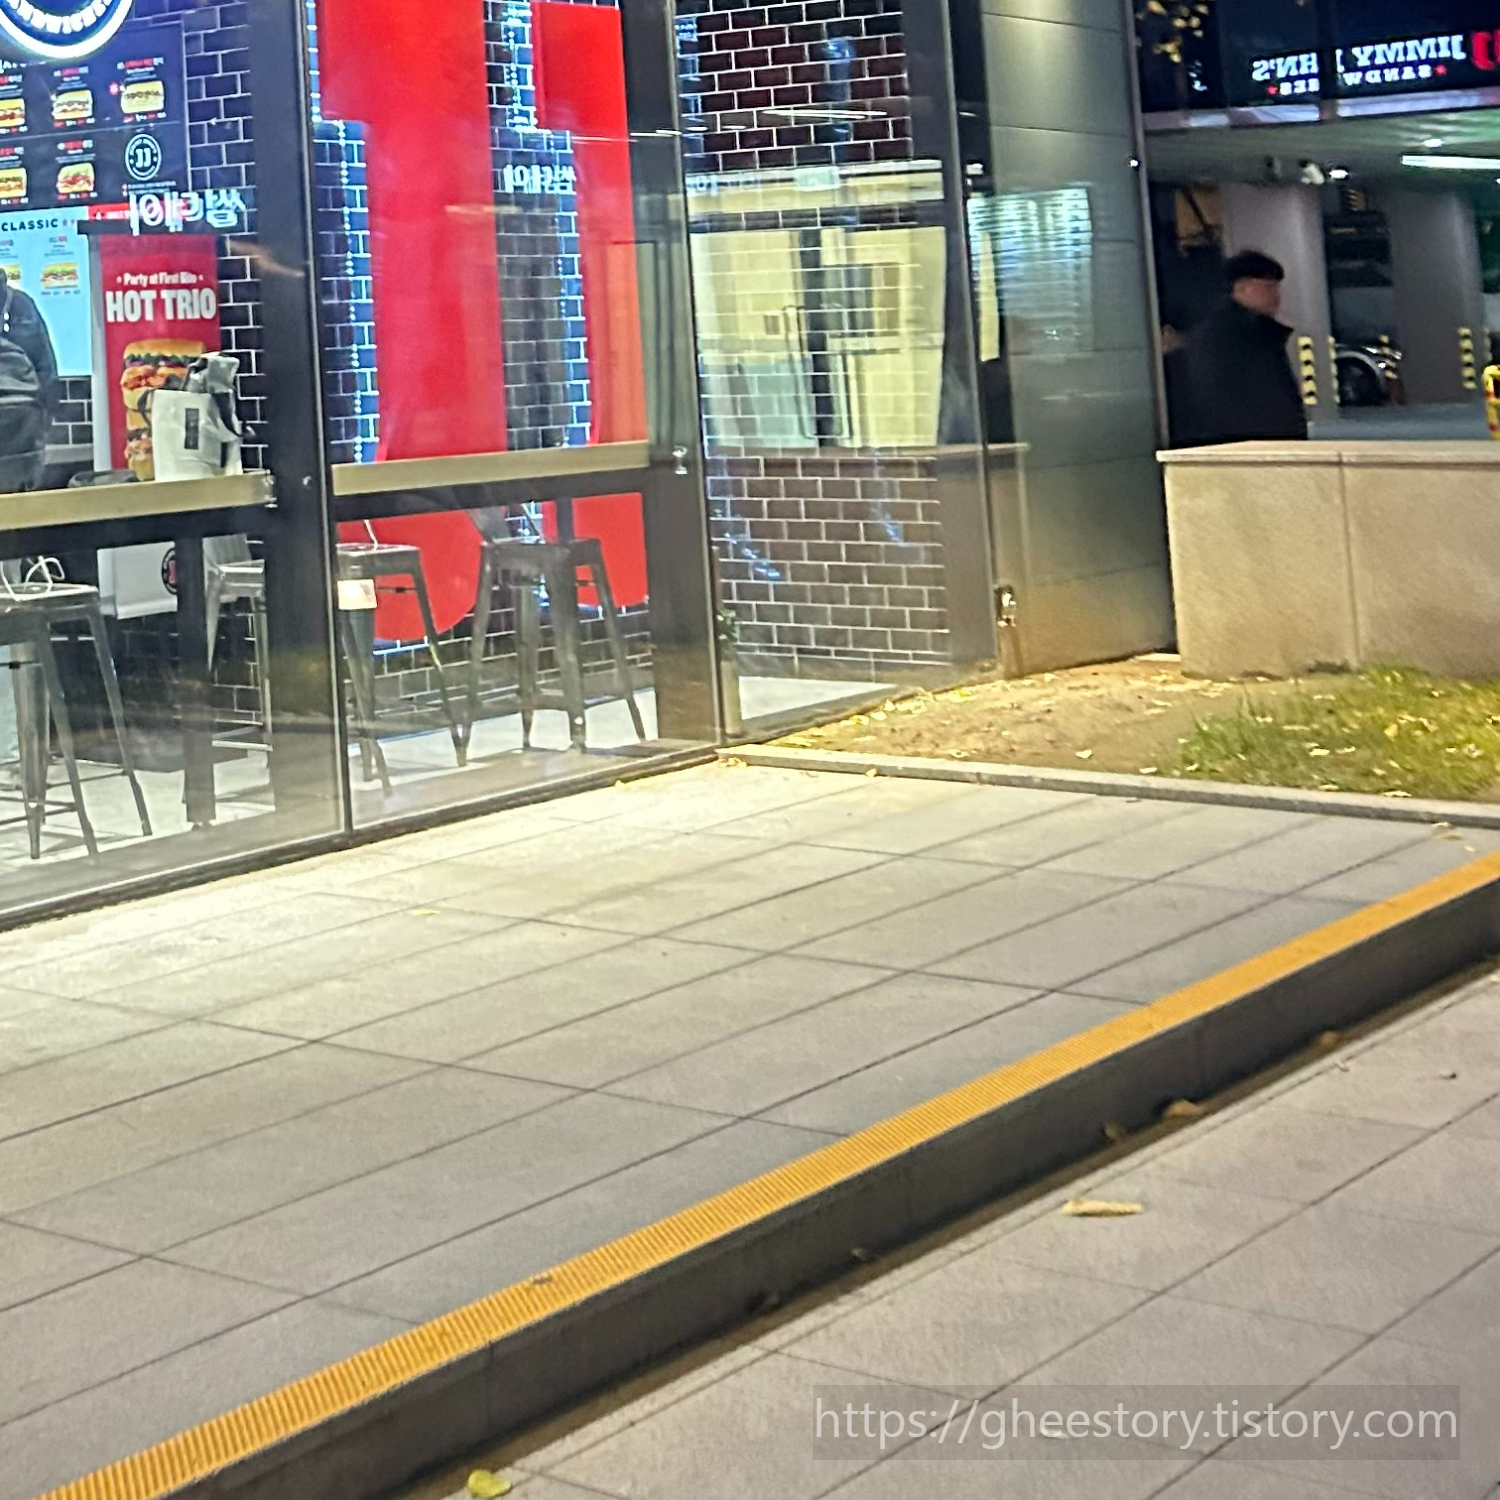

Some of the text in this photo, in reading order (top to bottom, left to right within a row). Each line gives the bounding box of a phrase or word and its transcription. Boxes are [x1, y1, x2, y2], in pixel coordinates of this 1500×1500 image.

[1, 218, 58, 232] CLASSIC
[123, 272, 148, 287] Party
[105, 288, 217, 323] HOT TRIO
